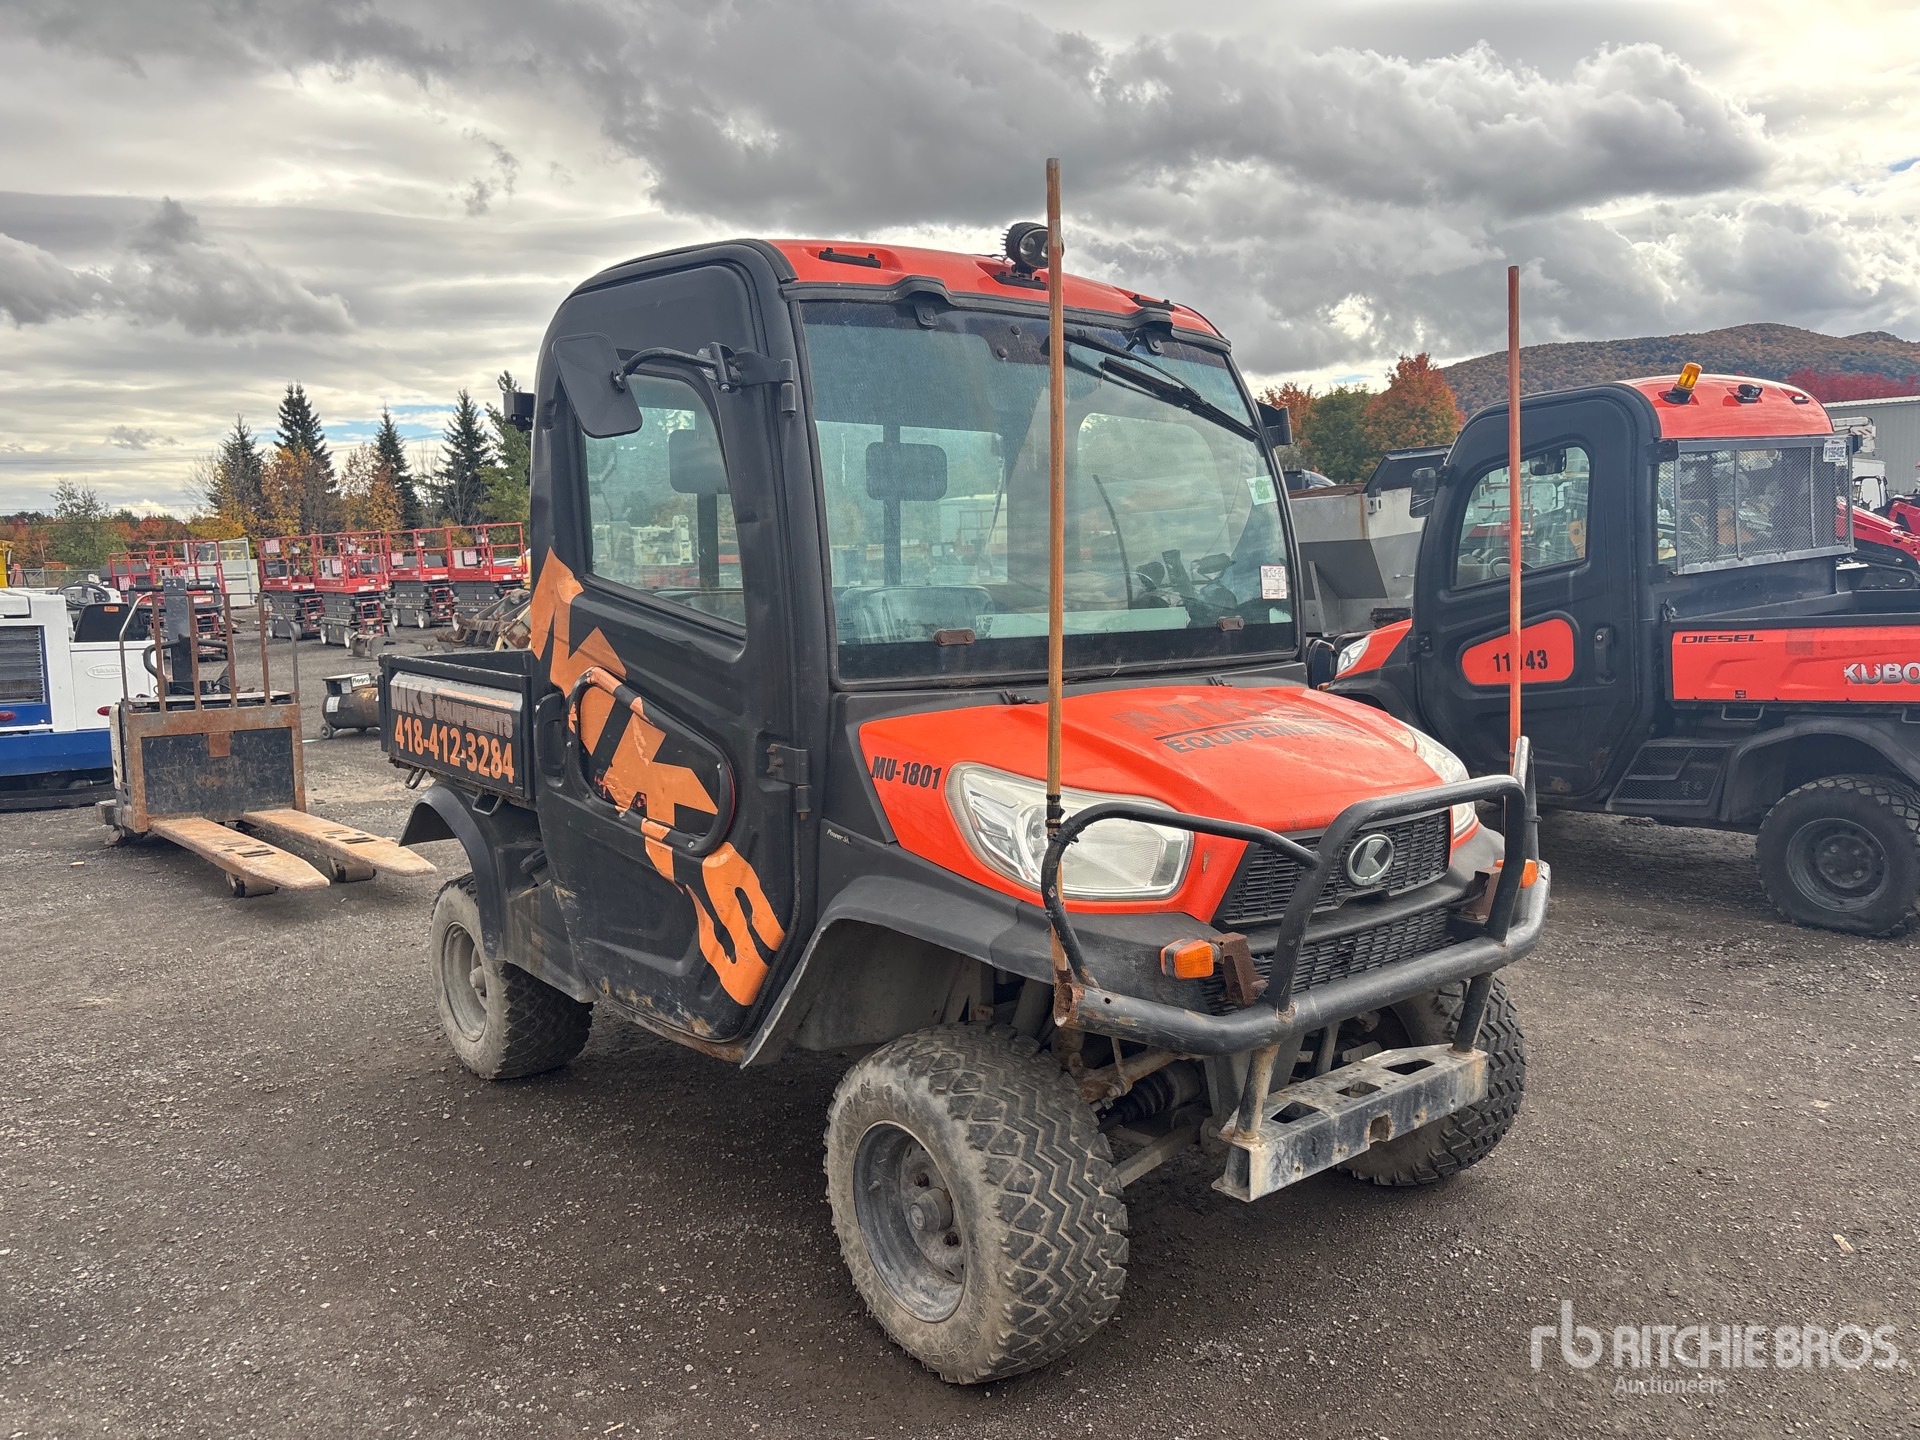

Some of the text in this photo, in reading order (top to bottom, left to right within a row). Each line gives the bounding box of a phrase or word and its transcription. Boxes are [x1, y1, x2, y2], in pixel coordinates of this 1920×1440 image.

[1681, 634, 1764, 644] DIESEL
[1493, 650, 1548, 672] 1143
[390, 680, 434, 719] MKS
[395, 714, 515, 784] 418-412-3284
[871, 755, 942, 790] MU-1801
